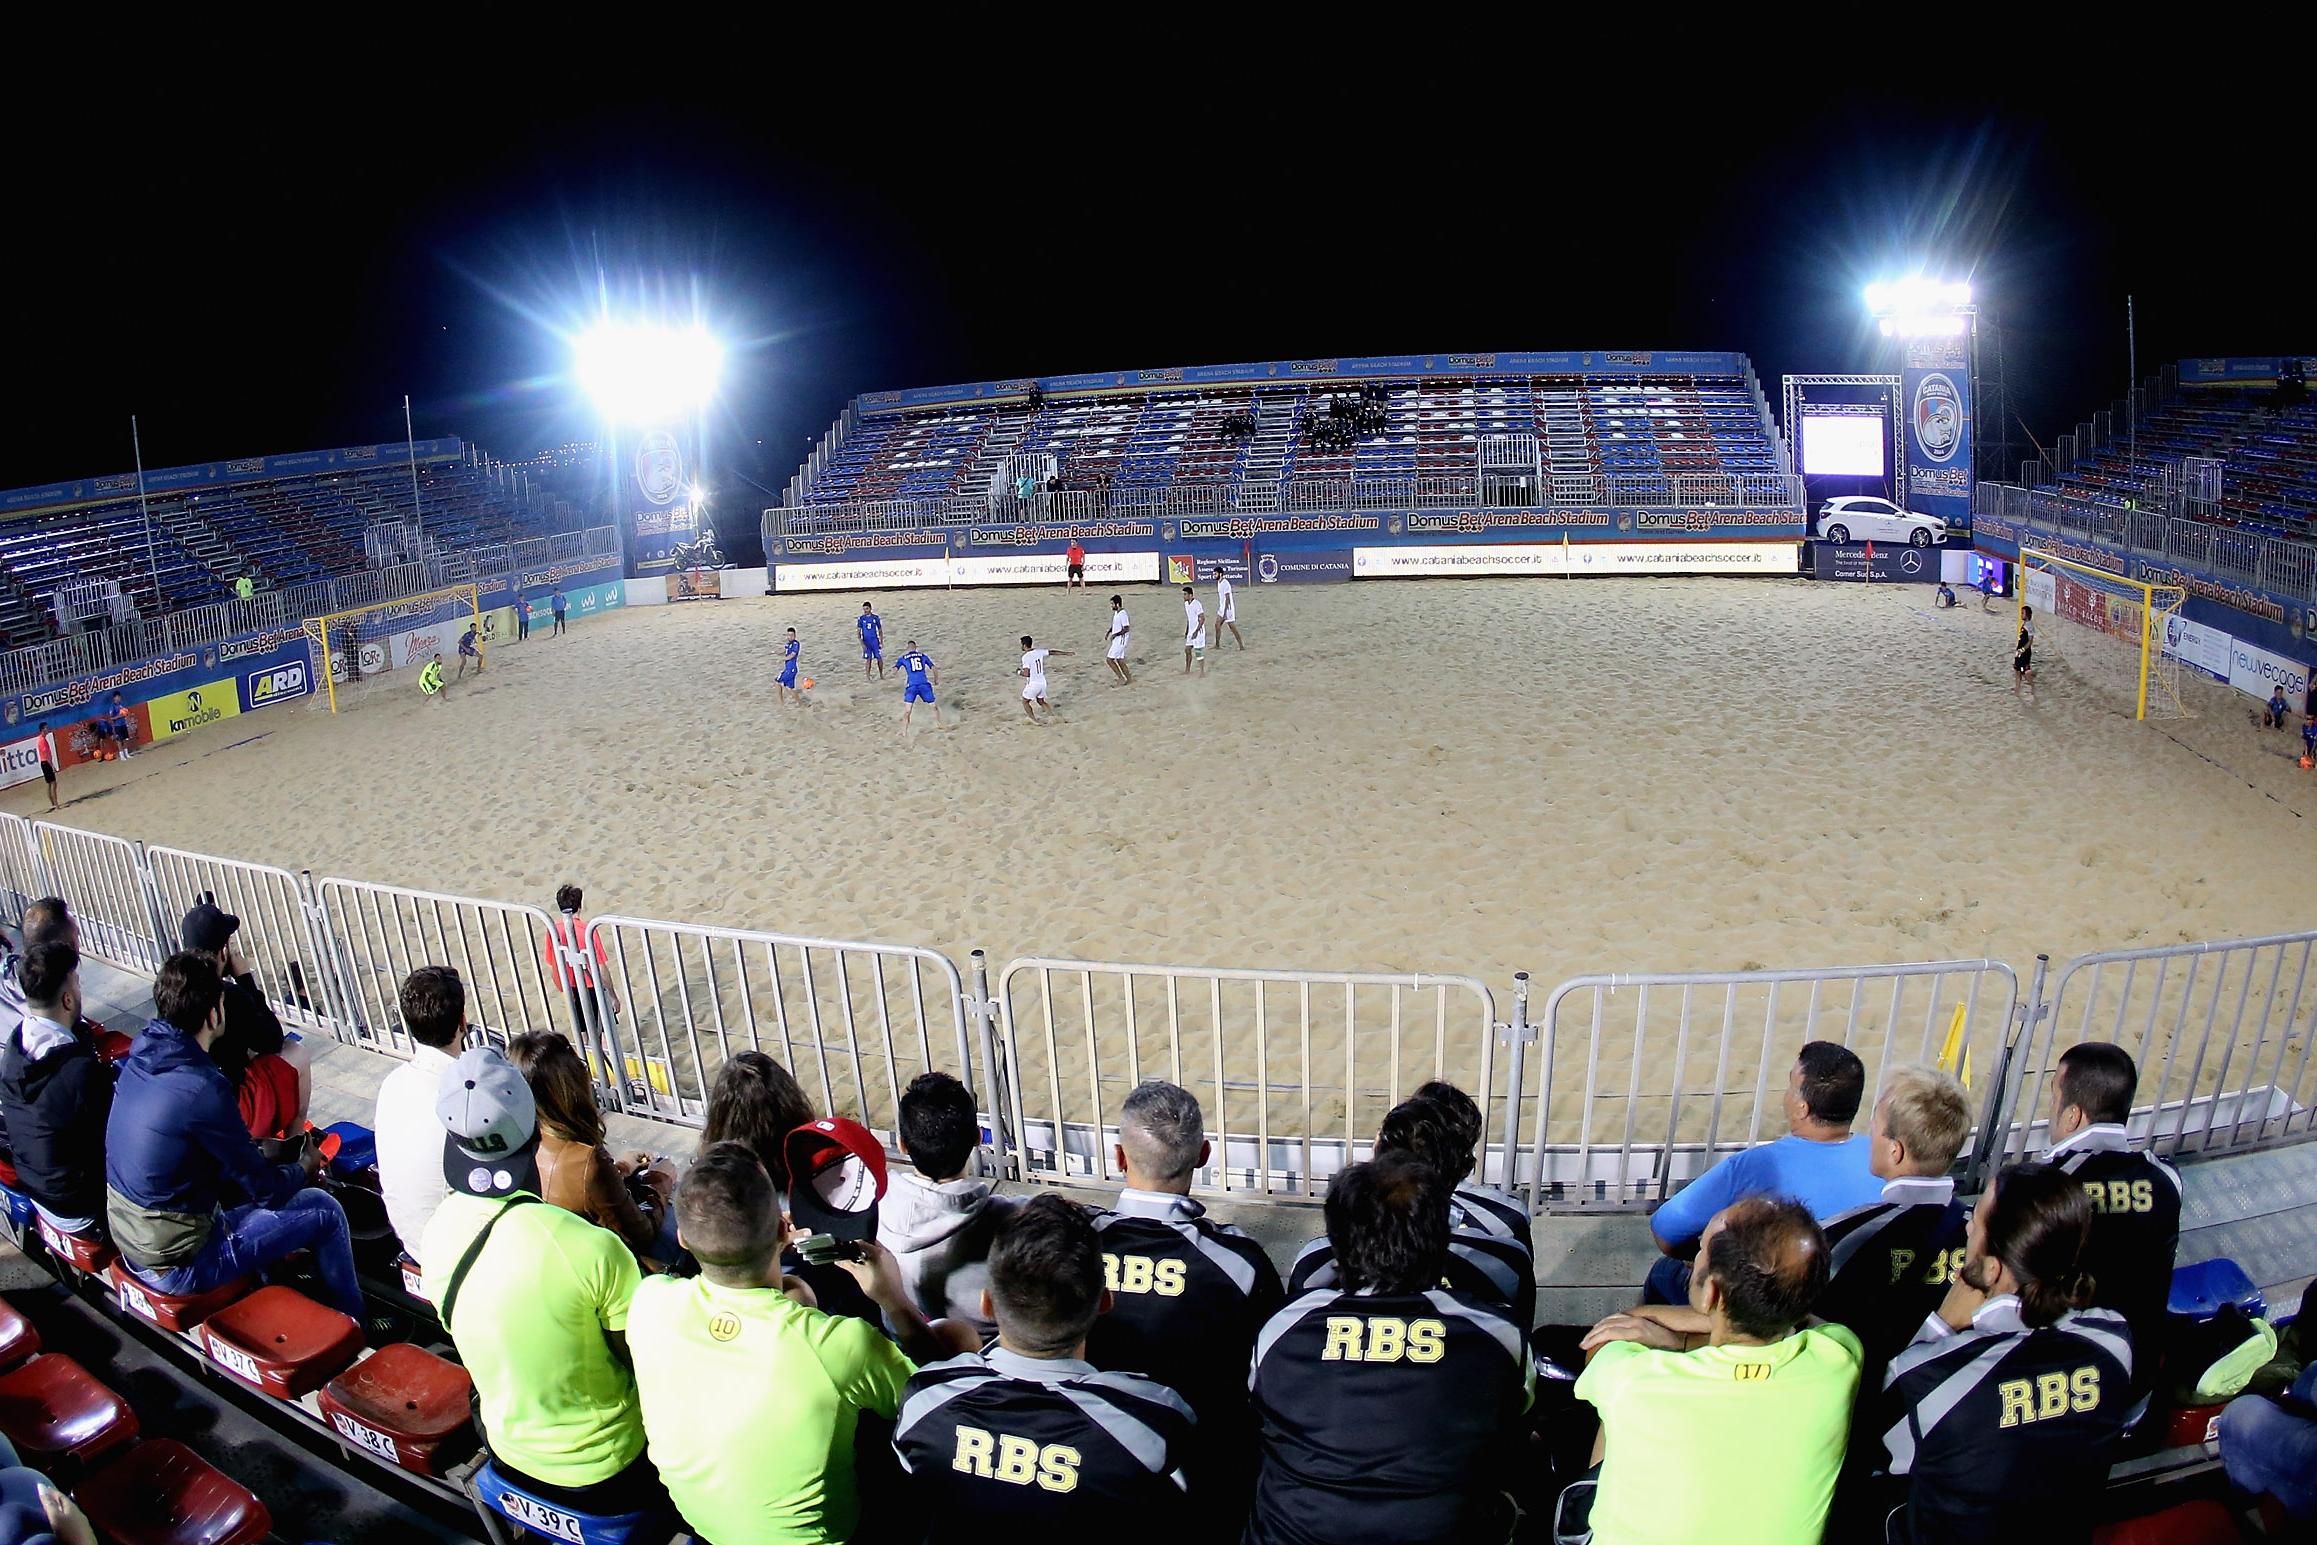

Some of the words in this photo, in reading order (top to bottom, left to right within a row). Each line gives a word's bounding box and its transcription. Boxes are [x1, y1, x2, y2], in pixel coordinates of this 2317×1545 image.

[1911, 465, 1968, 481] DomusBet
[1181, 518, 1254, 536] DomusBet
[1254, 518, 1291, 532] Arena
[1291, 515, 1326, 530] Beach
[1327, 513, 1379, 529] Stadium
[1408, 511, 1485, 529] DomusBet
[1485, 511, 1520, 526] Arena
[1521, 509, 1558, 525] Beach
[1558, 510, 1610, 526] Stadium
[1638, 510, 1711, 528] DomusBet
[1710, 511, 1744, 525] Arena
[1745, 511, 1780, 525] Beach
[787, 536, 844, 552] DomusBet
[844, 534, 873, 548] Arena
[873, 532, 903, 546] Beach
[903, 531, 947, 545] Stadium
[971, 526, 1037, 543] DomusBet
[1037, 526, 1070, 539] Arena
[1070, 523, 1104, 538] Beach
[1104, 521, 1153, 537] Stadium
[1319, 562, 1350, 571] CATANIA
[1391, 553, 1543, 566] www.cataniabeachsoccer.it
[1617, 552, 1762, 564] www.cataniabeachsoccer.it
[804, 567, 923, 581] www.cataniabeachsoccer.it
[478, 579, 508, 595] Stadium
[2188, 574, 2214, 599] Arena
[2214, 581, 2242, 608] Beach
[2242, 589, 2284, 624] Stadium
[219, 630, 278, 660] DomusBet
[278, 627, 304, 644] Arena
[911, 657, 923, 672] 16
[1035, 658, 1042, 674] 11
[2232, 650, 2307, 695] newvecogel
[23, 682, 91, 714] DomusBet
[91, 674, 122, 692] Arena
[122, 665, 154, 685] Beach
[154, 653, 197, 676] Stadium
[255, 667, 302, 697] ARD
[170, 707, 222, 733] knmobile
[2082, 1179, 2153, 1214] RBS
[1101, 1252, 1187, 1297] RBS
[714, 1318, 735, 1334] 10
[1322, 1316, 1446, 1363] RBS
[230, 1350, 244, 1371] 37
[247, 1358, 258, 1376] C
[1999, 1365, 2101, 1428] RBS
[359, 1426, 380, 1449] 38
[382, 1437, 395, 1456] C
[952, 1424, 1082, 1493] RBS
[537, 1506, 561, 1530] 39
[565, 1518, 579, 1538] C
